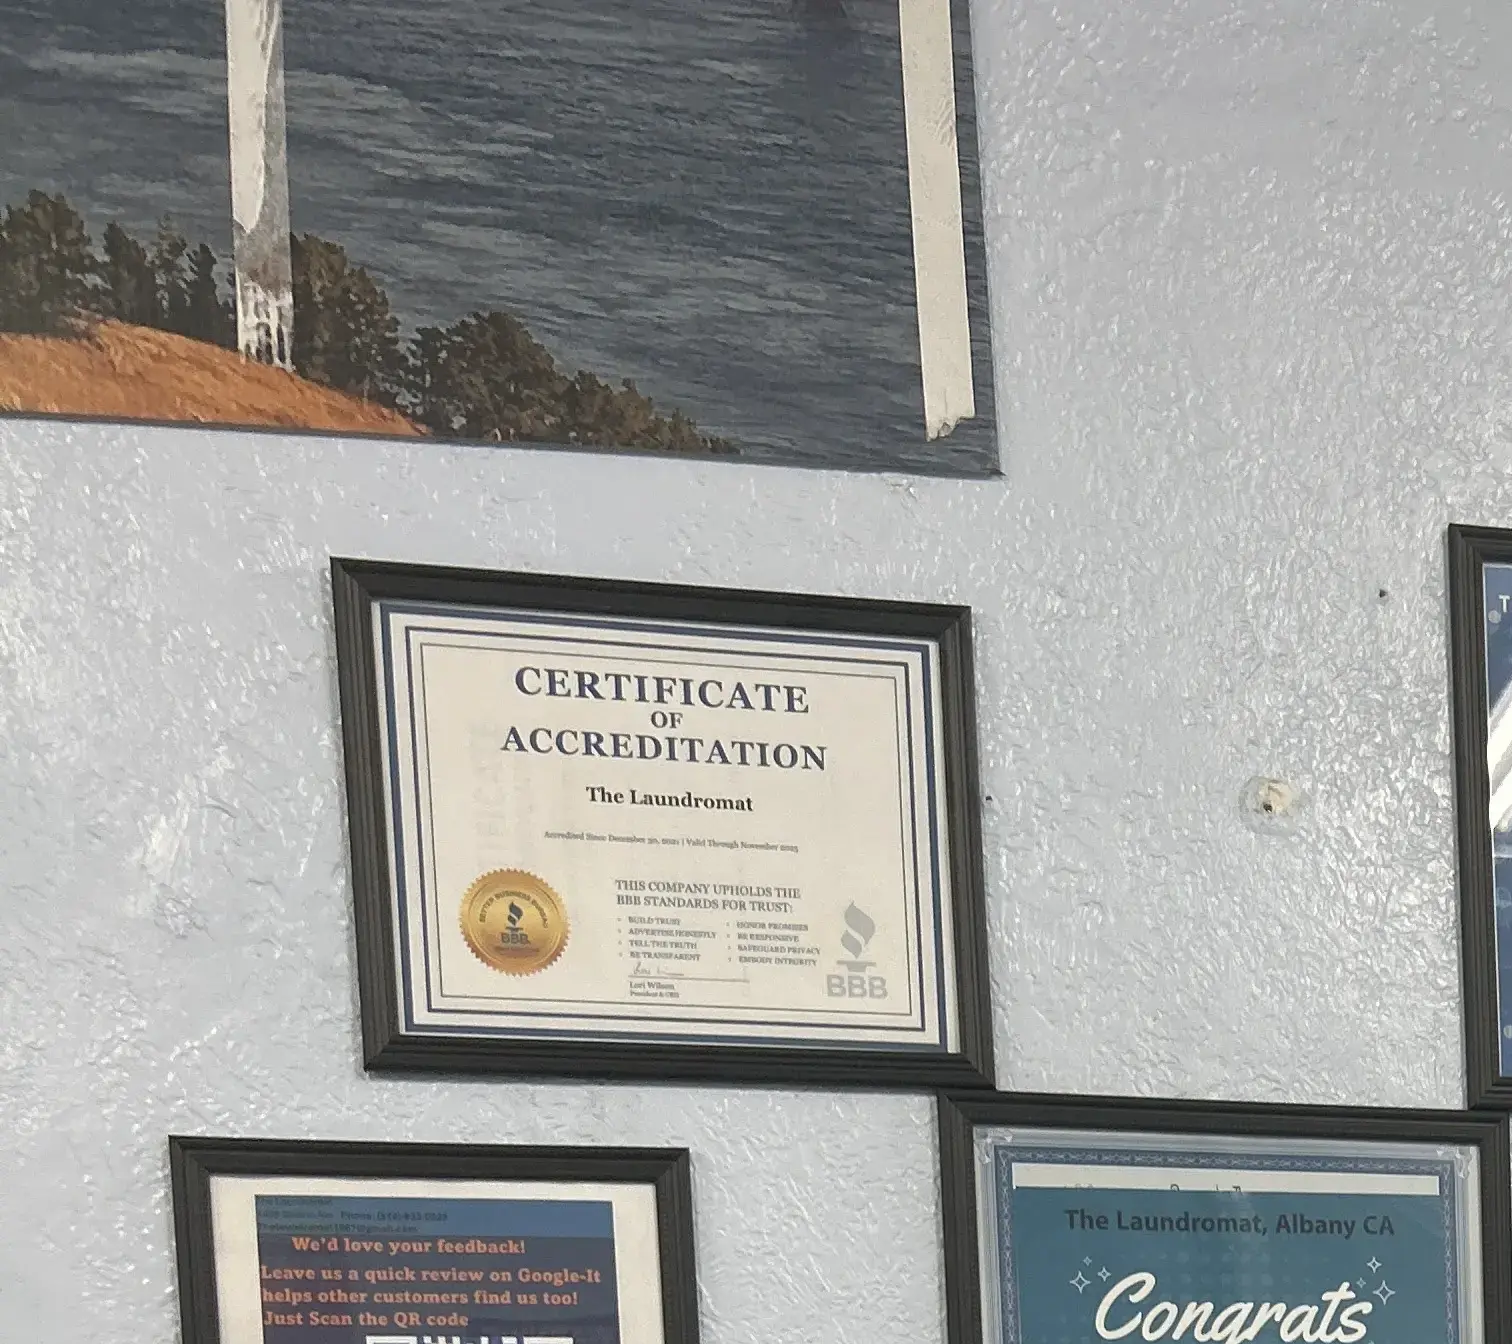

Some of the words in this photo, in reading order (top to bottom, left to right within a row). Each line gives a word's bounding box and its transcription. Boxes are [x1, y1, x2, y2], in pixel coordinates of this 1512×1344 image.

[515, 666, 809, 714] CERTIFICATE
[650, 711, 683, 729] OF
[502, 726, 827, 771] ACCREDITATION
[586, 786, 625, 805] The
[629, 789, 753, 812] Laundromat
[615, 880, 646, 891] THIS
[648, 881, 710, 894] COMPANY
[713, 884, 772, 897] UPHOLDS
[774, 887, 801, 899] THE
[617, 894, 643, 906] BBB
[644, 896, 719, 909] STANDARDS
[722, 900, 747, 911] FOR
[827, 974, 888, 999] BBB
[1064, 1208, 1109, 1231] The
[1117, 1210, 1269, 1237] Laundromat,
[1275, 1213, 1355, 1240] Albany
[1363, 1215, 1395, 1237] CA
[344, 1237, 384, 1252] love
[388, 1241, 432, 1257] your
[437, 1238, 526, 1255] feedback!
[261, 1266, 315, 1281] Leave
[321, 1269, 342, 1281] us
[348, 1270, 359, 1281] a
[364, 1266, 416, 1285] quick
[420, 1268, 483, 1282] review
[489, 1270, 512, 1283] on
[518, 1267, 601, 1287] Google-It
[262, 1288, 312, 1306] helps
[318, 1290, 366, 1304] other
[373, 1291, 468, 1305] customers
[473, 1290, 511, 1305] find
[516, 1293, 538, 1305] us
[543, 1290, 579, 1306] too!
[264, 1311, 303, 1326] Just
[309, 1311, 352, 1326] Scan
[359, 1312, 387, 1326] the
[393, 1312, 421, 1328] QR
[427, 1313, 469, 1327] code
